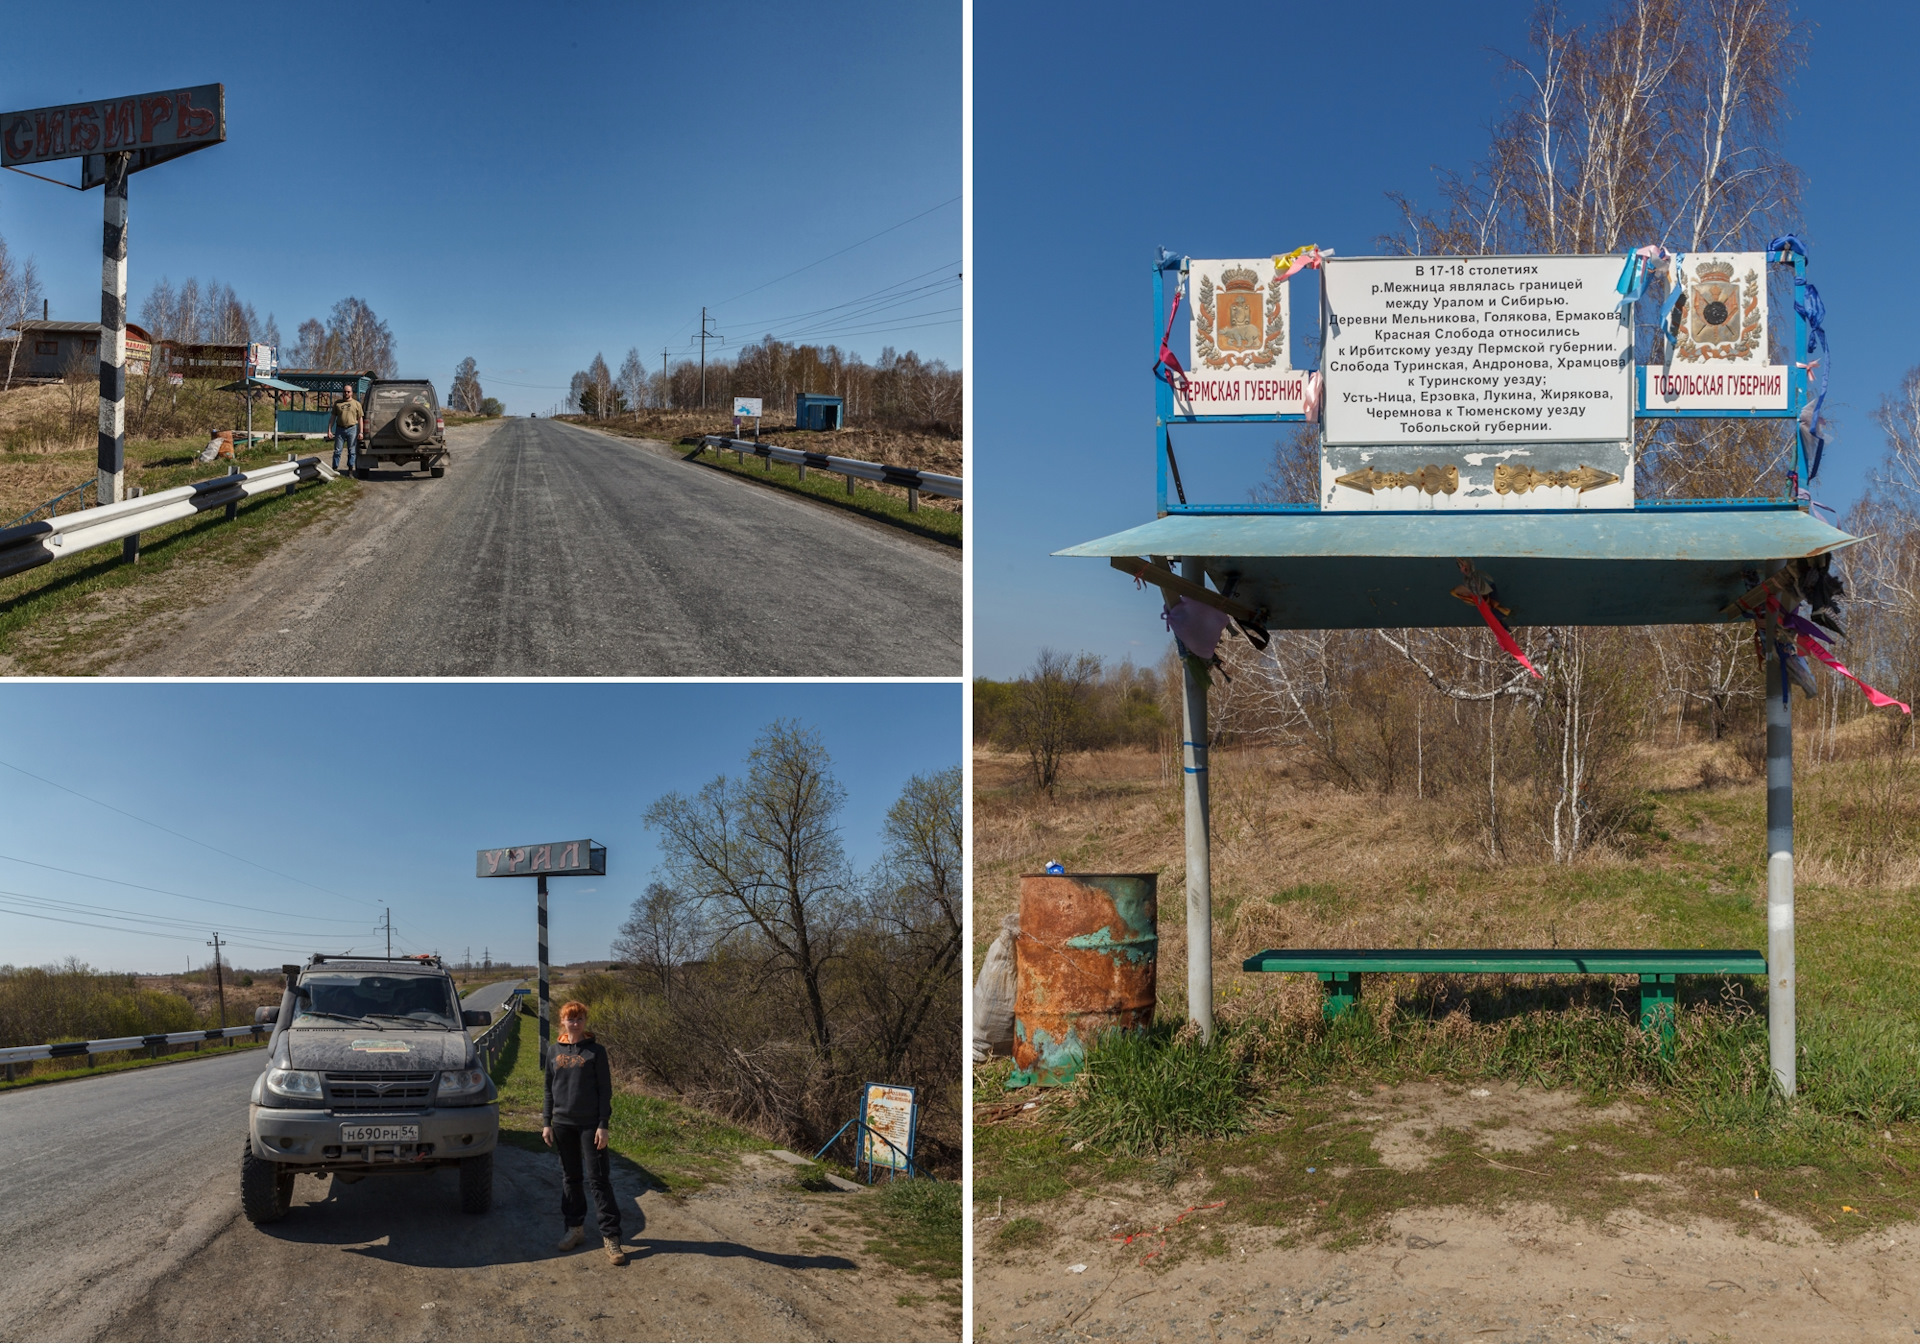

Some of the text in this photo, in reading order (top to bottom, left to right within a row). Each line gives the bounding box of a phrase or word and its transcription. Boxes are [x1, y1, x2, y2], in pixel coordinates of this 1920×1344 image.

[3, 92, 216, 160] СИБИРЬ
[1415, 265, 1538, 277] В 17-18 столетиях
[1371, 278, 1583, 296] р.Межница являлась границей
[1385, 295, 1569, 311] между Уралом и Сибирью.
[1329, 311, 1626, 326] Деревни Мельникова, Голякова, Ермакова,
[1375, 327, 1580, 341] Красная Слобода относились
[1338, 341, 1617, 359] к Ирбитскому уезду Пермской губернии.
[1330, 357, 1626, 374] Слобода Туринская, Андронова, Храмцова
[1408, 375, 1546, 389] к Туринскому уезду;
[1654, 374, 1782, 396] ТОБОЛЬСКАЯ ГУБЕРНИЯ
[1244, 380, 1303, 401] ГУБЕРНИЯ
[1342, 388, 1613, 404] Усть-Ница, Ерзовка, Лукина, Жирякова,
[1366, 405, 1586, 420] Черемнова к Тюменскому уезду
[1399, 420, 1552, 435] Тобольской губернии.
[485, 842, 580, 874] УРАЛ
[347, 1126, 415, 1140] Н690РН 54
